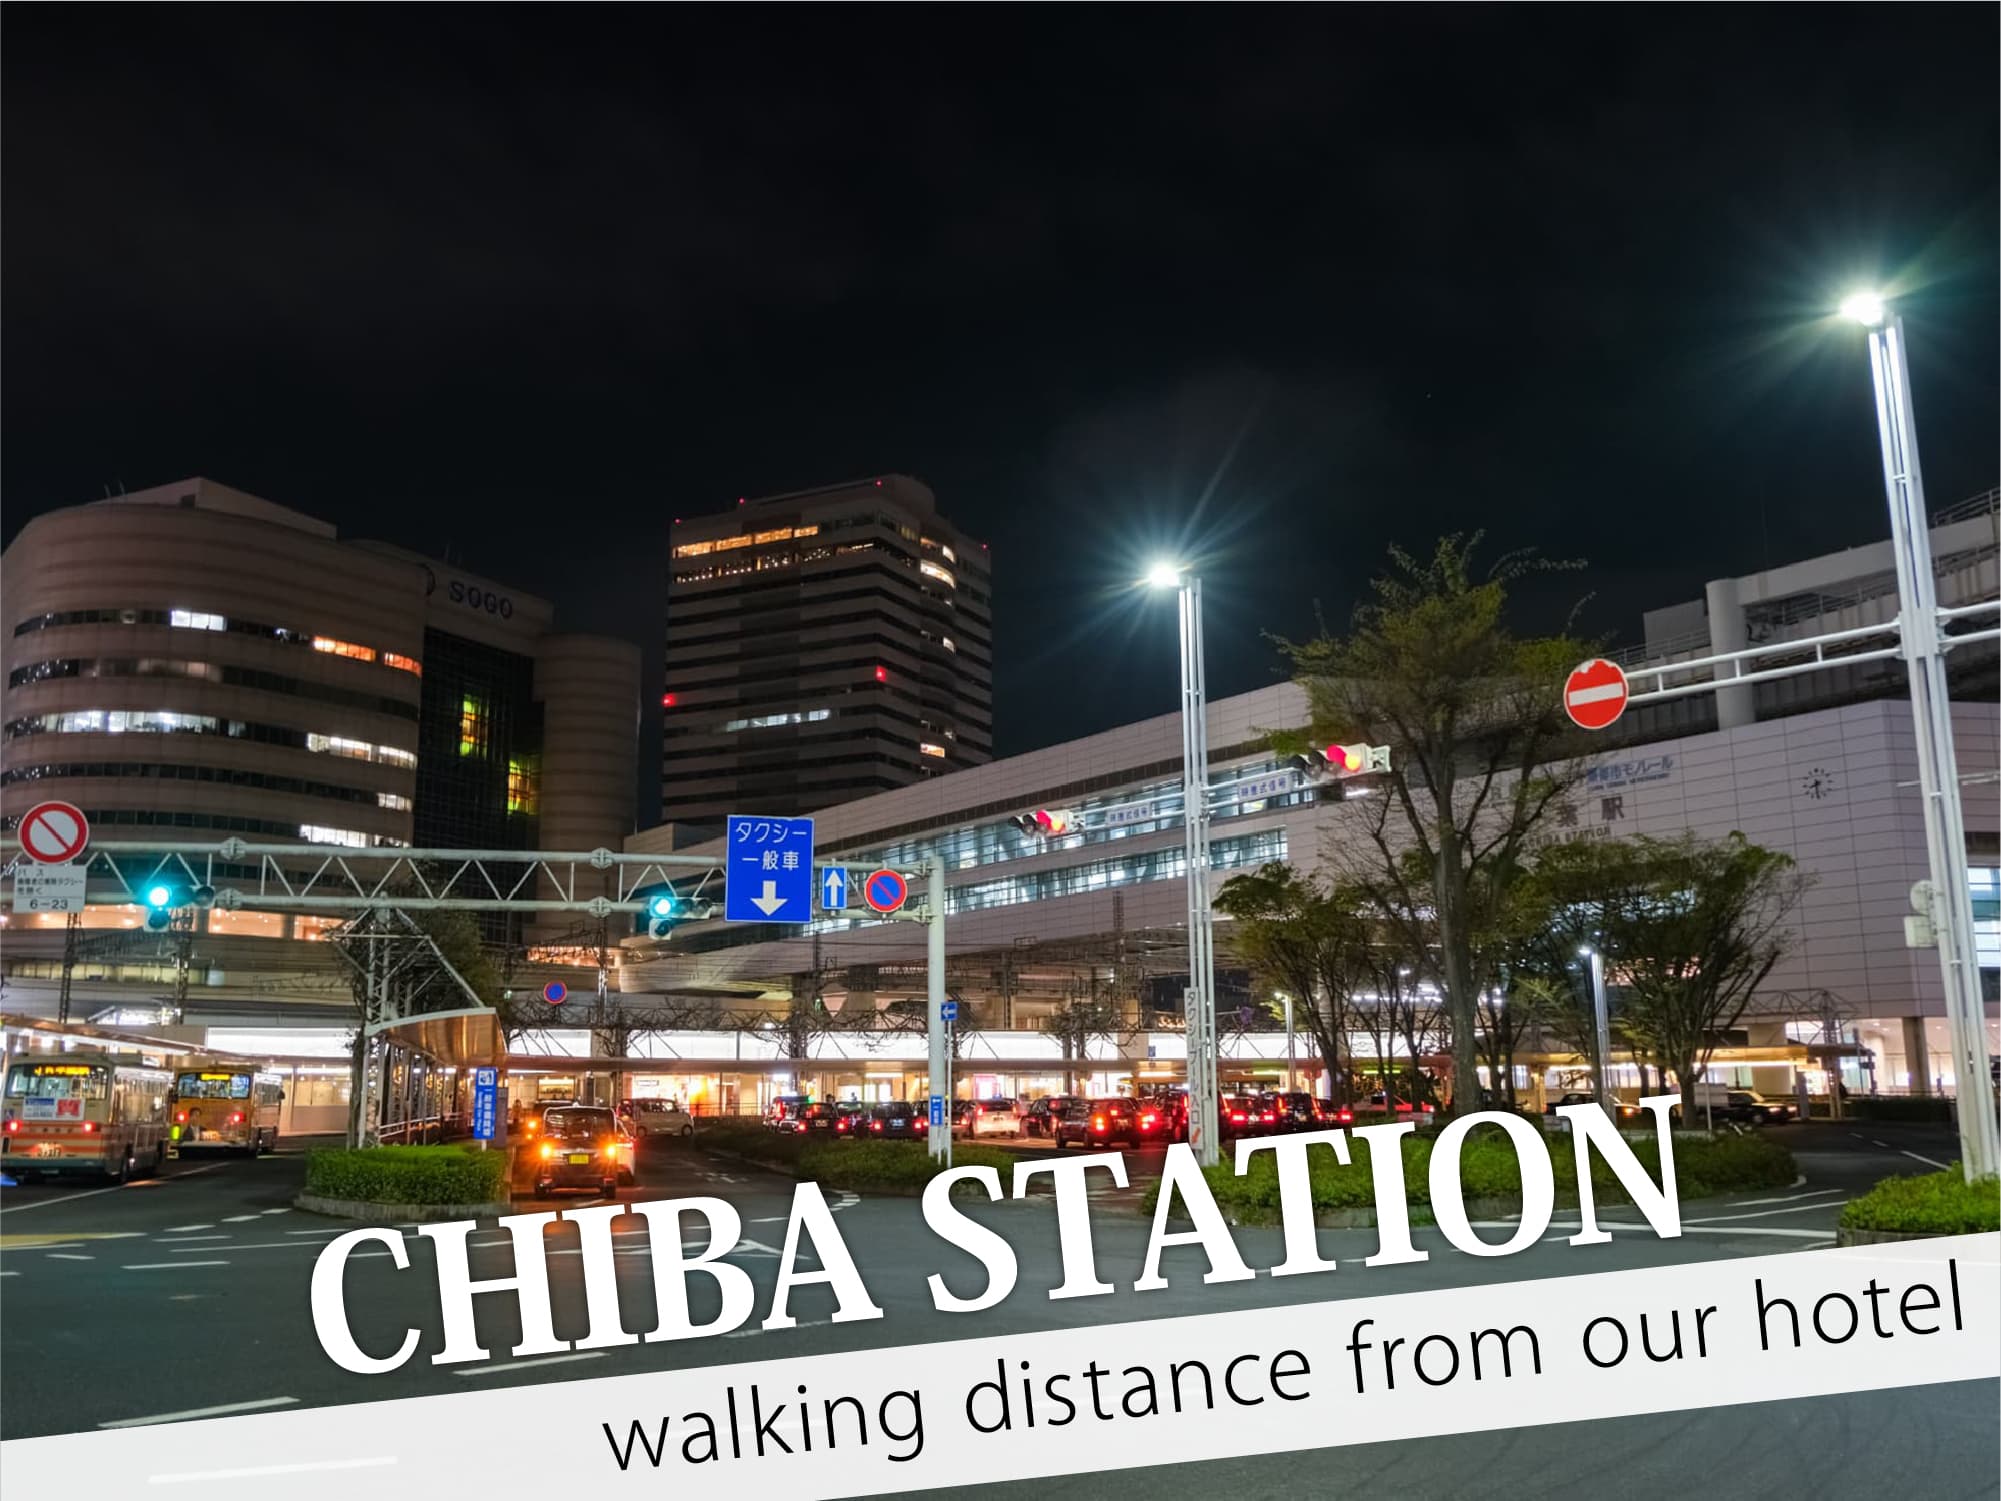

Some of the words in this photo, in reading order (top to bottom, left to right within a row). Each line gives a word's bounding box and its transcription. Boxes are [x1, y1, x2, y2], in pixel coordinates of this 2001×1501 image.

[448, 581, 513, 619] SOGO
[735, 822, 807, 843] タクシー
[741, 850, 799, 871] 一般車
